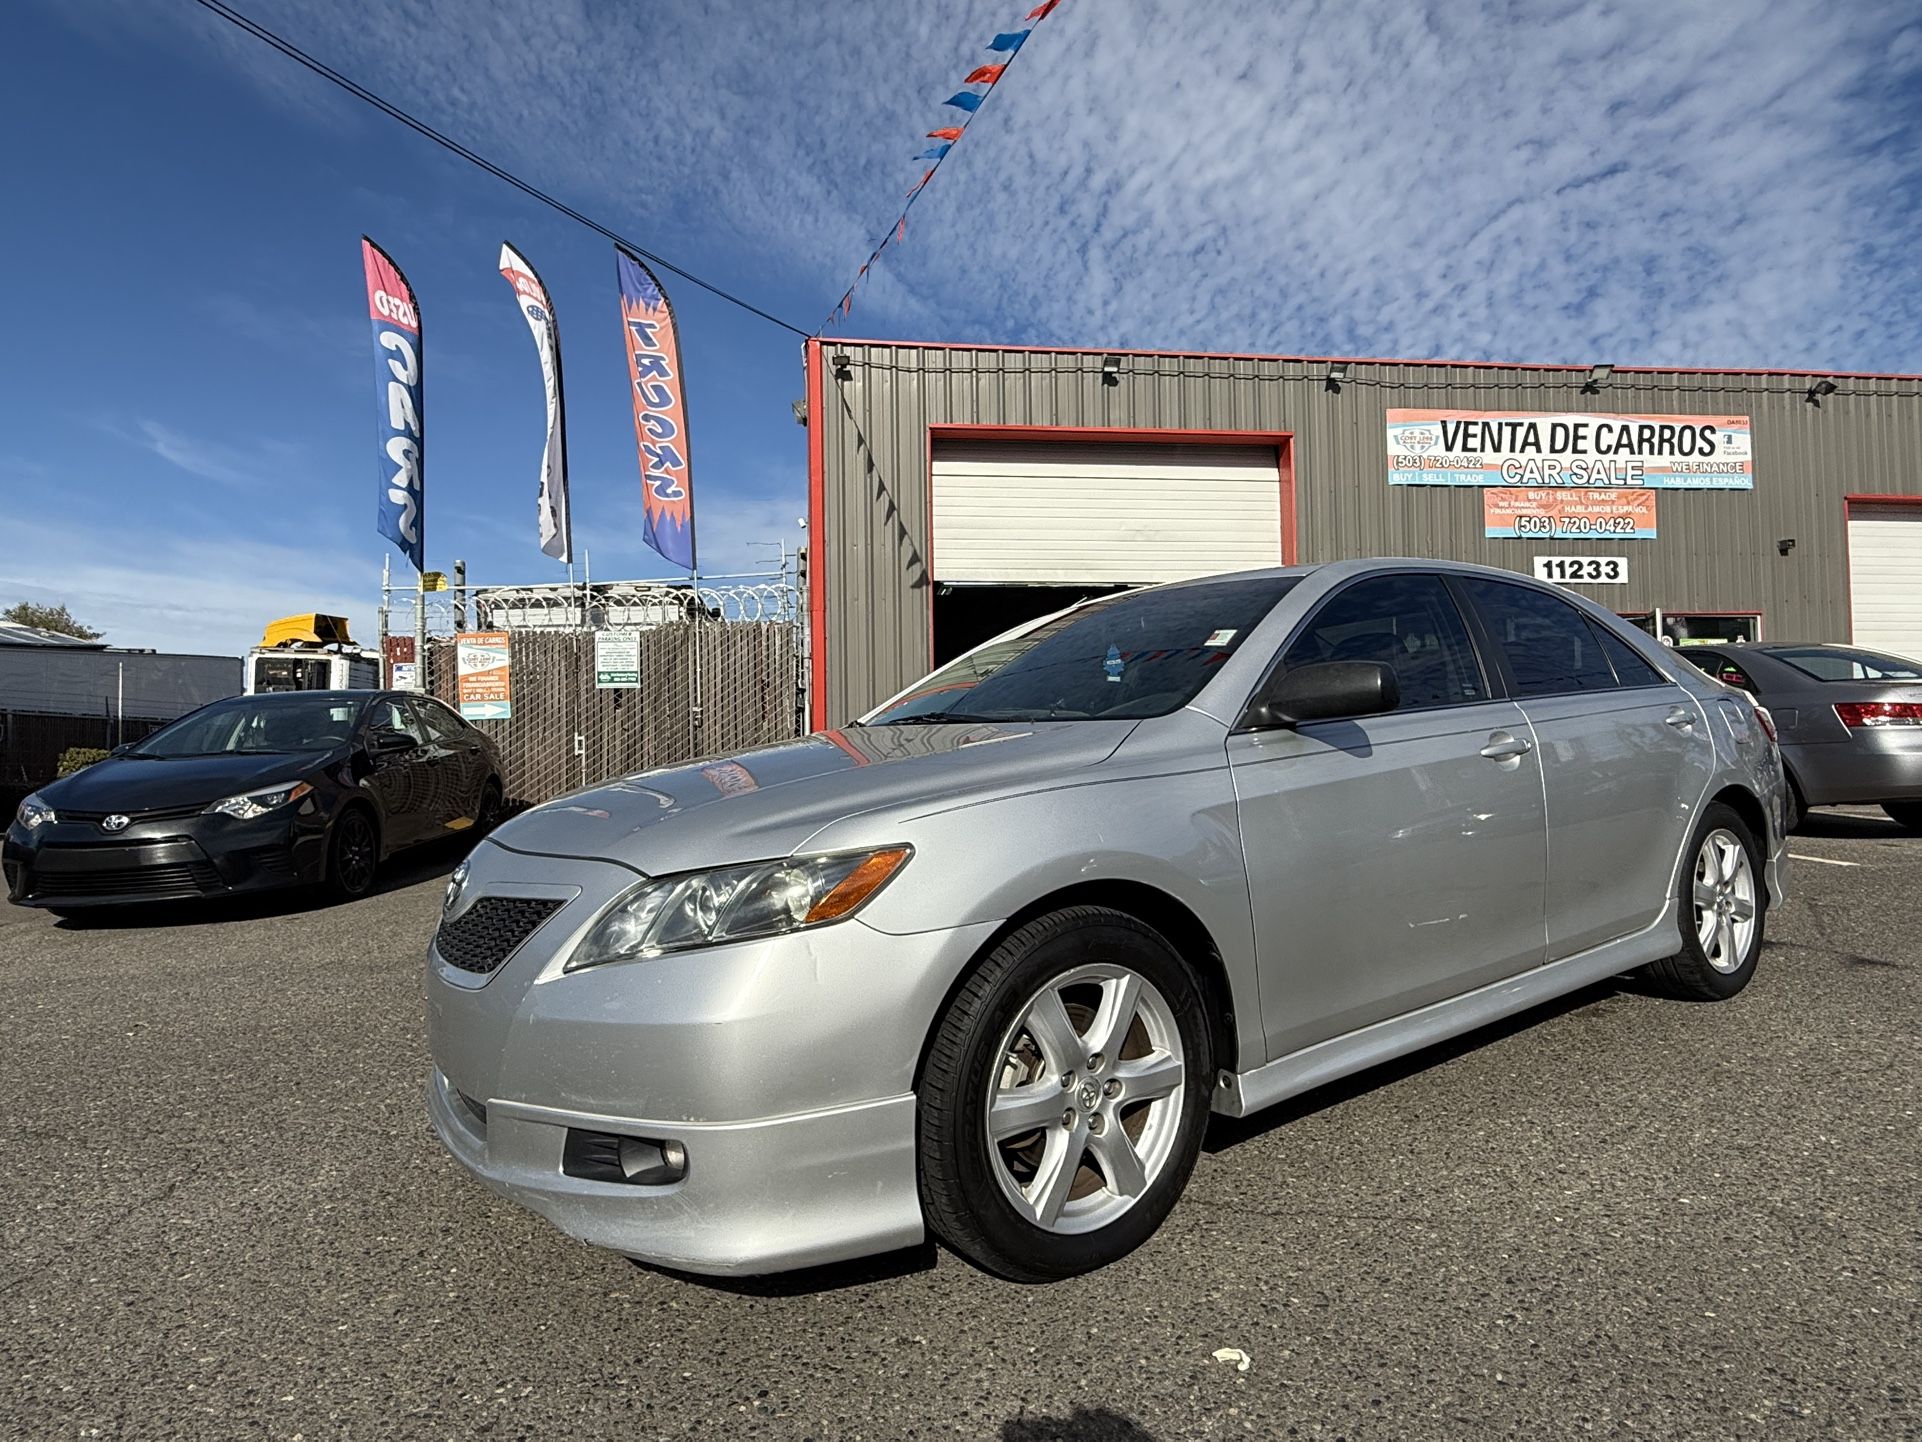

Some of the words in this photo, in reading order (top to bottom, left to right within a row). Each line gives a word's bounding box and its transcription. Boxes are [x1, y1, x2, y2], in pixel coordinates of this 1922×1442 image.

[1440, 420, 1542, 453] VENTA
[1550, 422, 1589, 455] DE
[1595, 424, 1717, 457] CARROS
[1393, 455, 1425, 470] (503)
[1429, 456, 1483, 469] 720-0422
[1670, 461, 1690, 473] WE
[1692, 462, 1744, 473] FINANCE
[1501, 458, 1565, 485] CAR
[1570, 459, 1645, 486] SALE
[1393, 474, 1413, 482] BUY
[1422, 474, 1445, 482] SELL
[1455, 474, 1485, 483] TRADE
[1663, 476, 1711, 486] HABLAMOS
[1713, 476, 1751, 487] ESPAÑOL
[1528, 492, 1547, 500] BUY
[1556, 492, 1579, 501] SELL
[1588, 492, 1618, 501] TRADE
[1564, 505, 1611, 514] HABLAMOS
[1514, 516, 1556, 537] (503)
[1560, 516, 1636, 534] 720-0422
[1543, 560, 1620, 580] 11233
[463, 693, 482, 701] CAR
[484, 692, 505, 700] SALE
